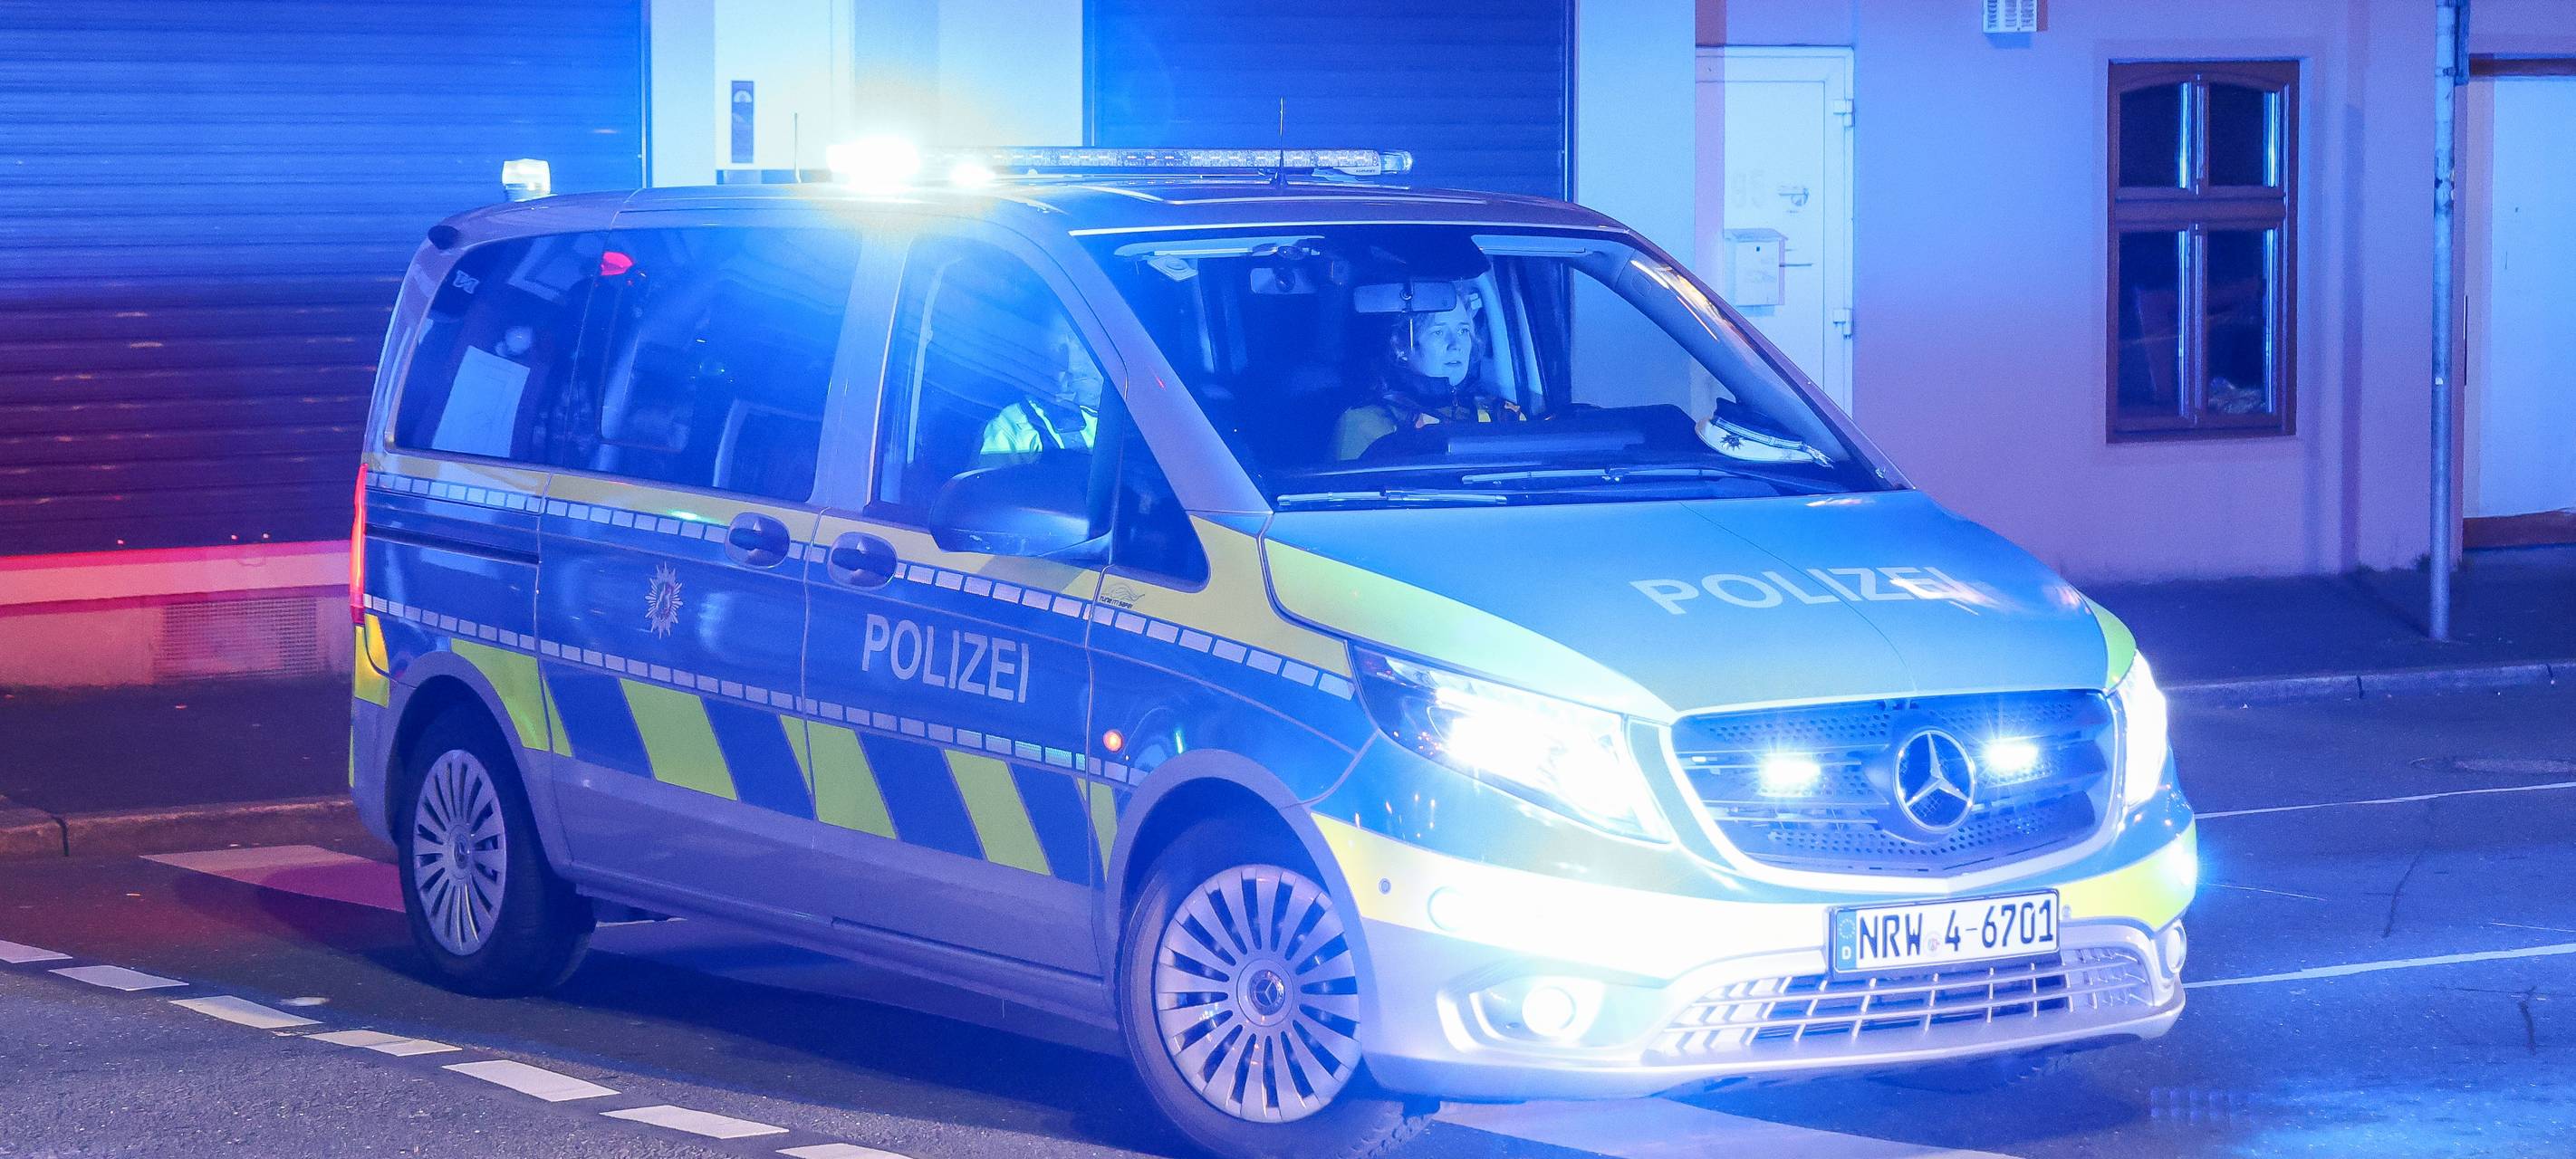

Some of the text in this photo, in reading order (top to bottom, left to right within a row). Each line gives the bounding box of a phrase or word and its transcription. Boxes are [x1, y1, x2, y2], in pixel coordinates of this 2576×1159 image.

[1629, 566, 1985, 616] POLIZEI
[861, 613, 1029, 704] POLIZEI
[1841, 946, 1851, 960] D
[1860, 899, 2054, 959] NRW 4-6701
